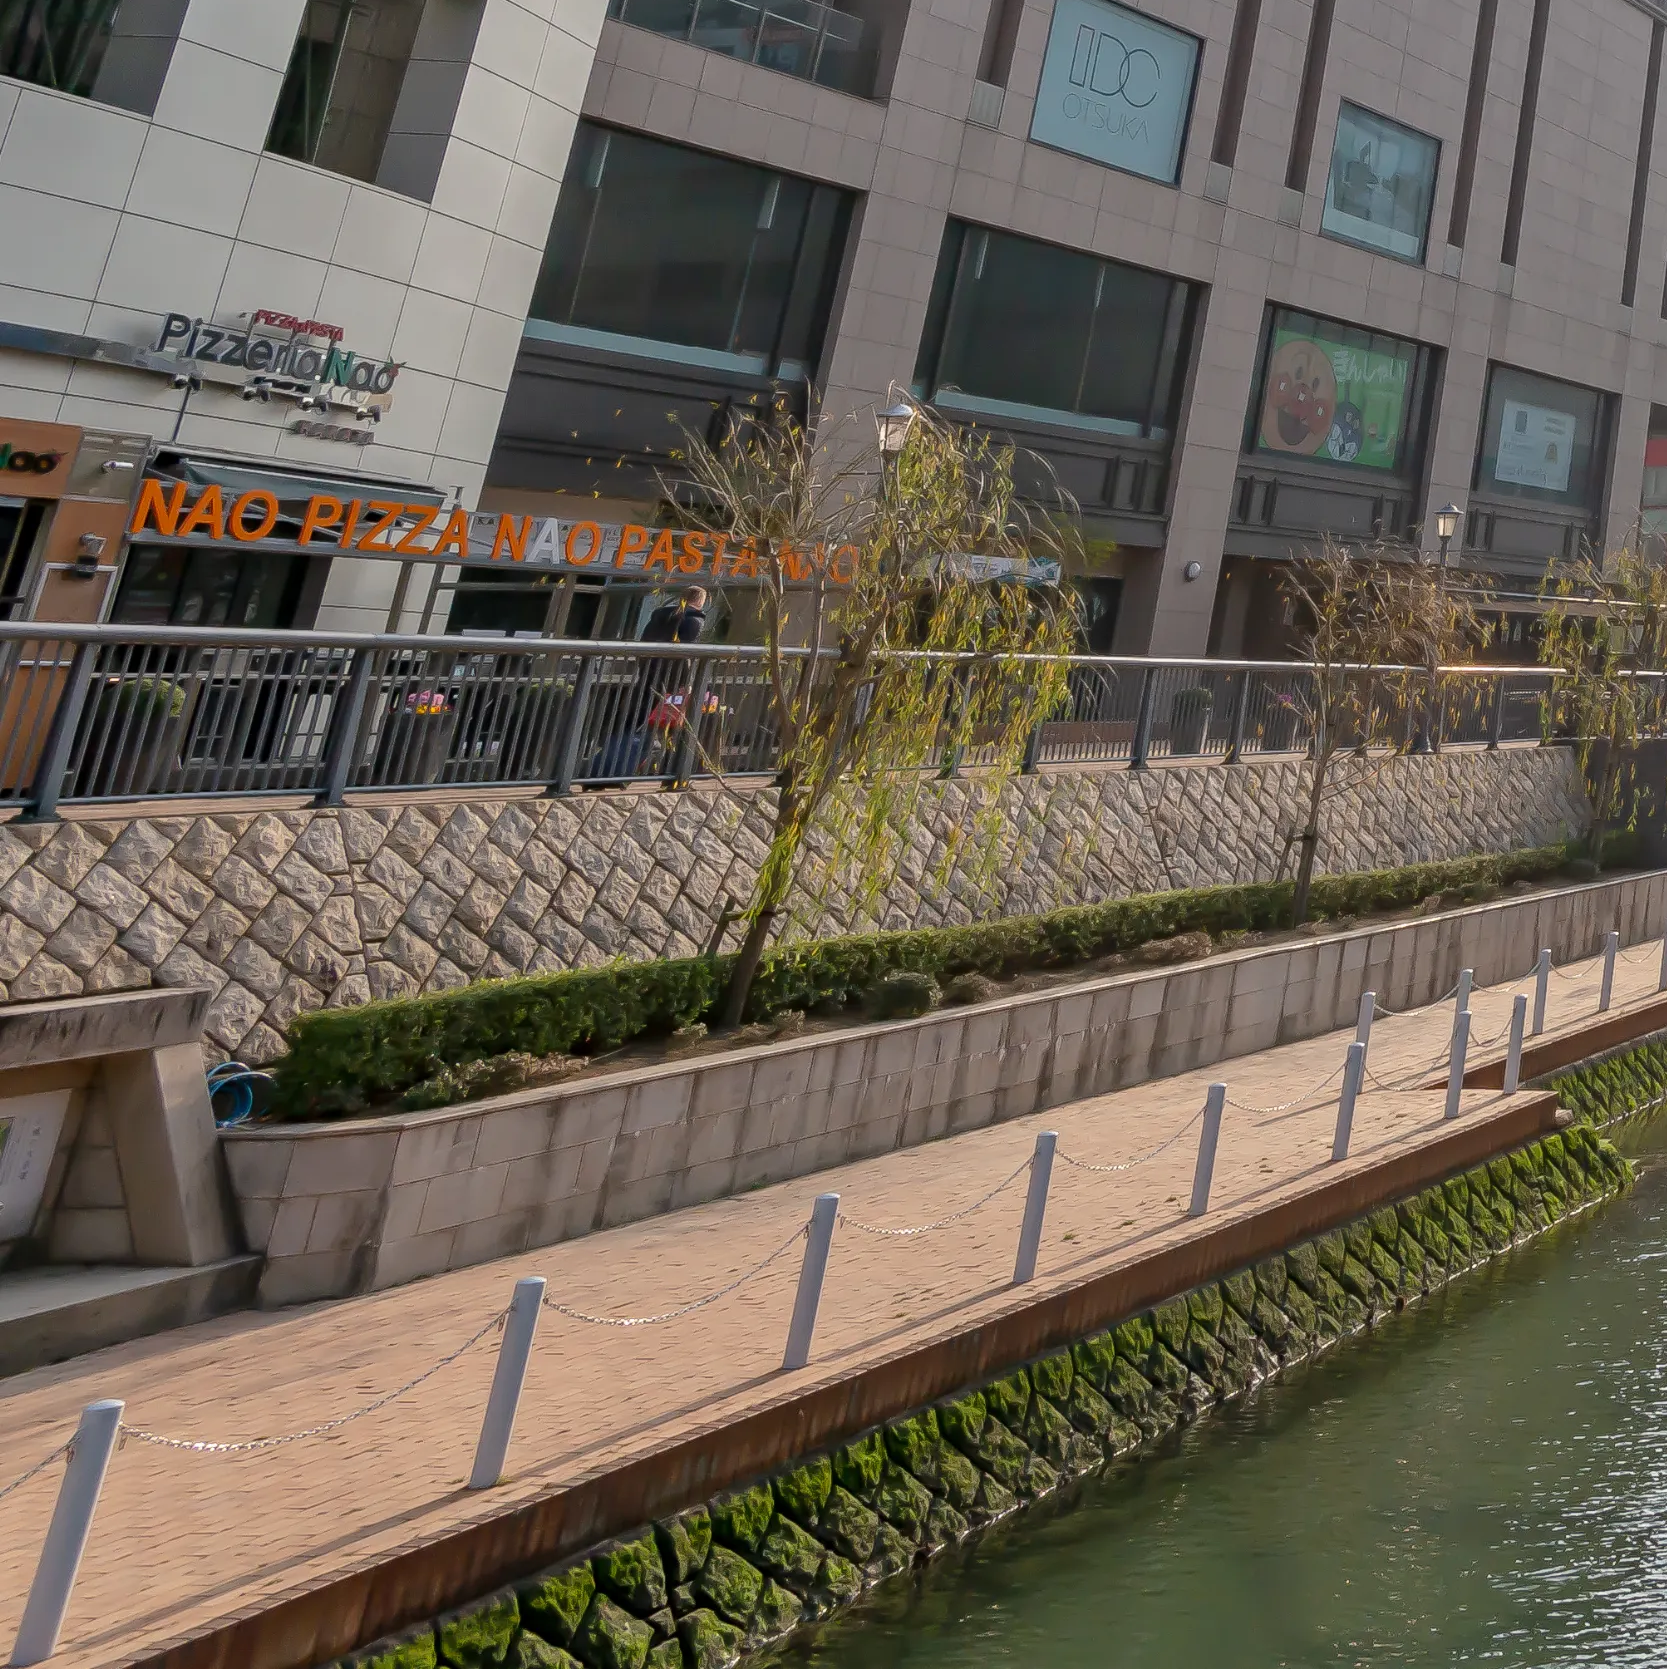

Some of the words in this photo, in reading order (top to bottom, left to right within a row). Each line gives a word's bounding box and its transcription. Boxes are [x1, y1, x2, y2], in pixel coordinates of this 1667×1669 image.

[1069, 23, 1161, 108] IDC
[1062, 92, 1149, 145] OTSUKA
[154, 311, 322, 381] Pizzeria
[320, 345, 397, 395] Nao
[129, 478, 280, 542] NAO
[296, 494, 469, 558] PIZZA
[490, 512, 600, 566] NAO
[614, 524, 758, 579] PASTA
